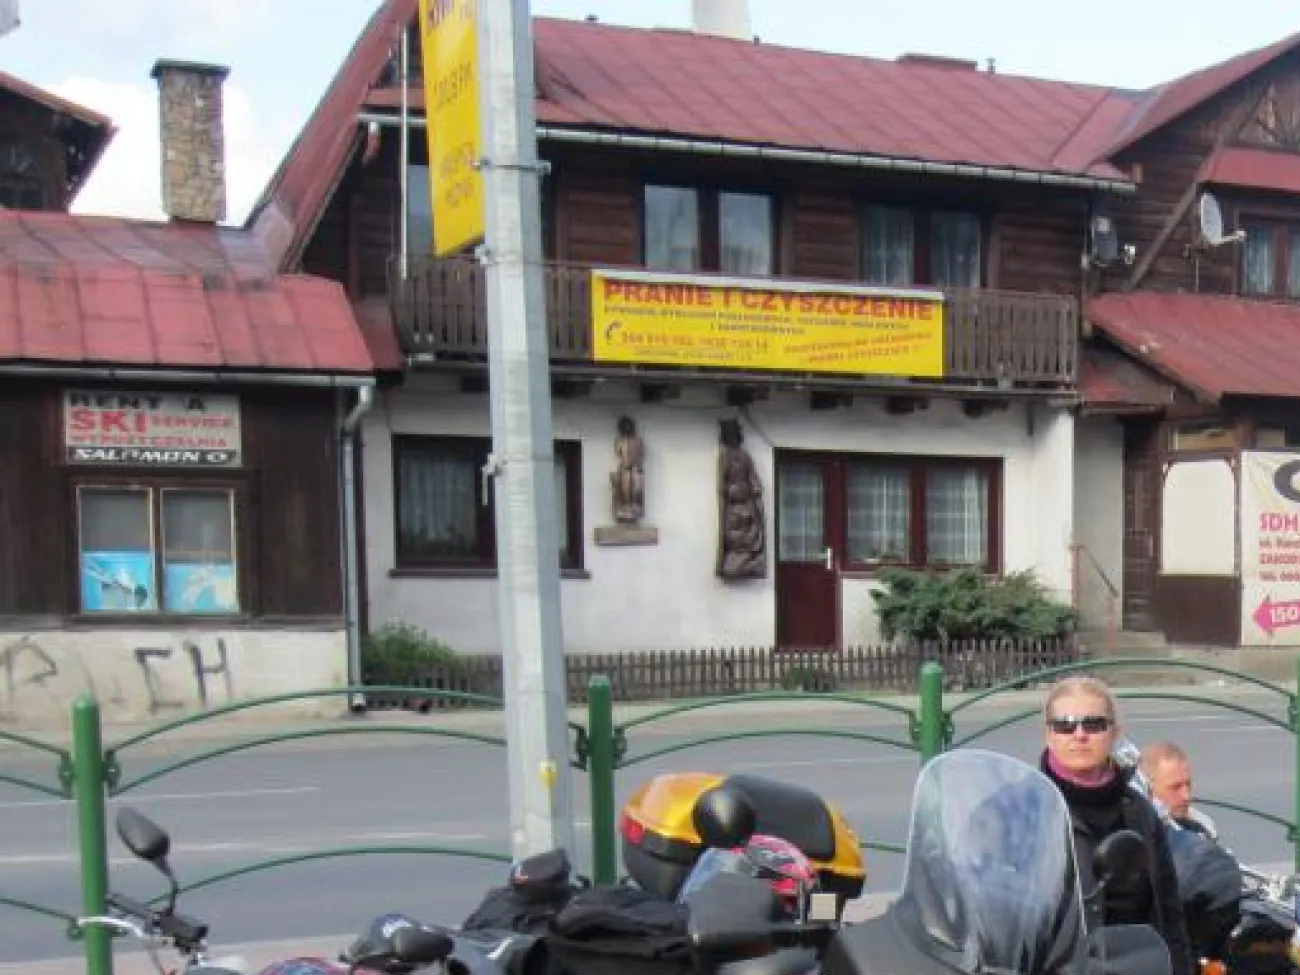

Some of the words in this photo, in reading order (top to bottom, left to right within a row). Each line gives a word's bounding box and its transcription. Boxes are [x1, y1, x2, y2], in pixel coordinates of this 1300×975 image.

[603, 278, 712, 306] PRANIE
[722, 287, 732, 307] I
[741, 289, 935, 321] CZYSZCZENIE
[70, 408, 147, 433] SKI
[74, 448, 200, 463] SALOMON
[1258, 512, 1299, 532] SDH
[1269, 606, 1298, 624] 150
